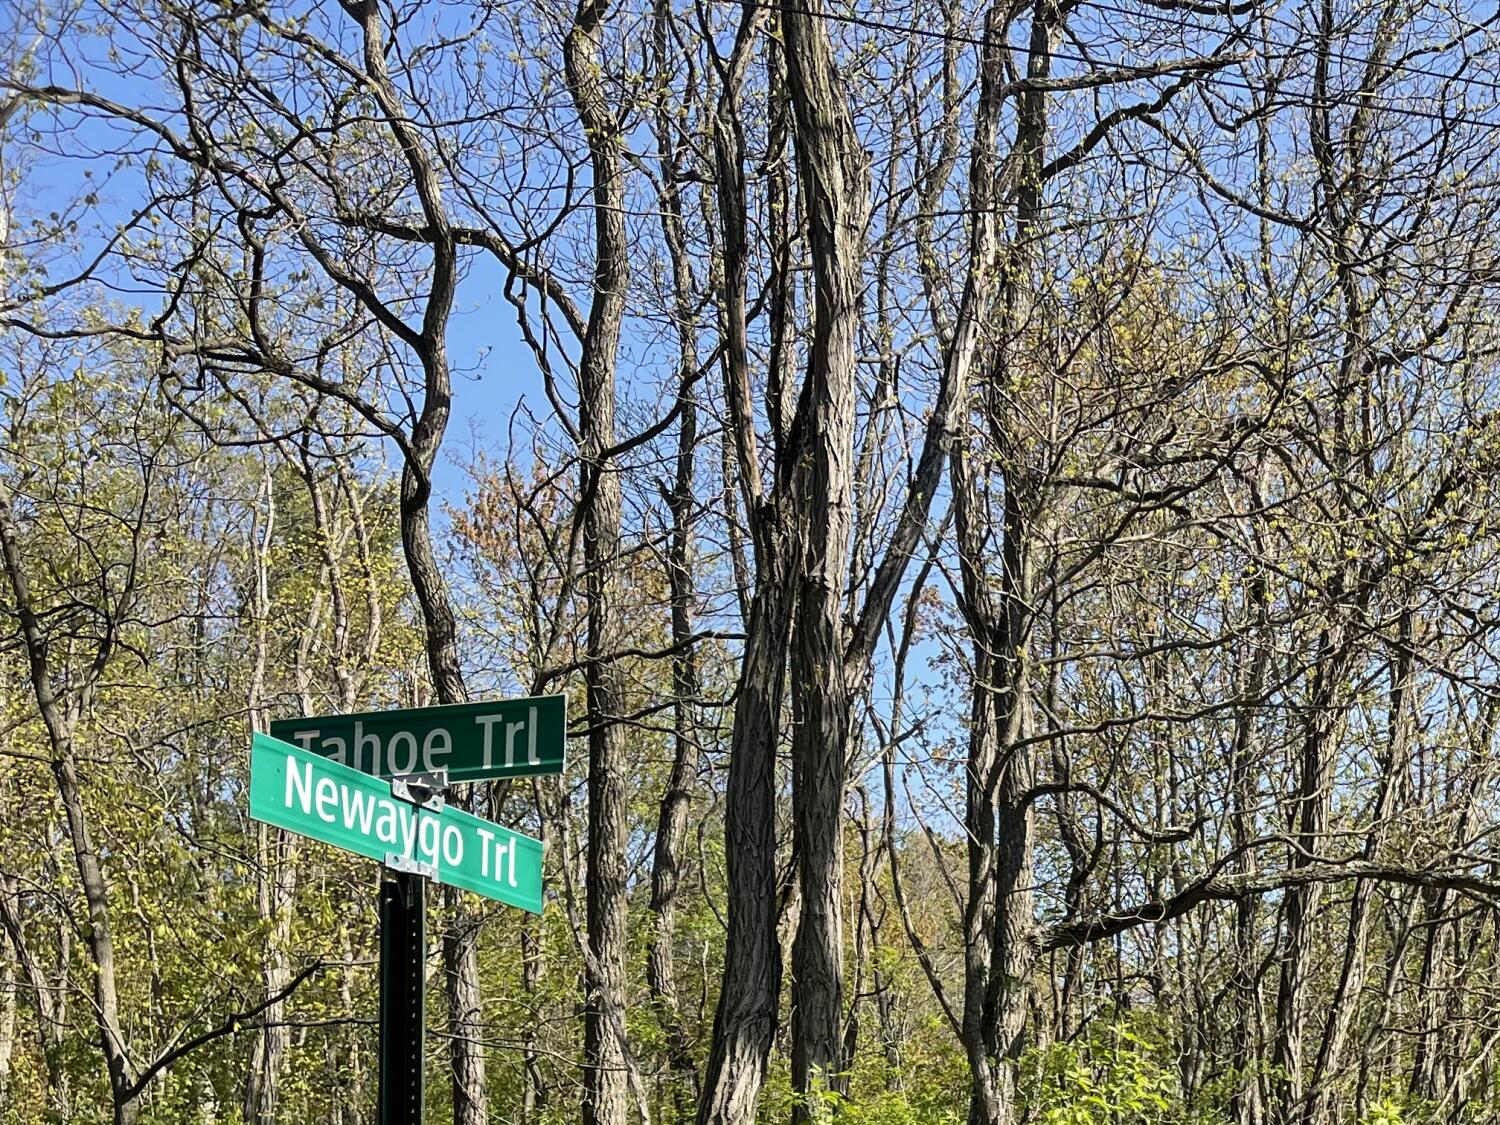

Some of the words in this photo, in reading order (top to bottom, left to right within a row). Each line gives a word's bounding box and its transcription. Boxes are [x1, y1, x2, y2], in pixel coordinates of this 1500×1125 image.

[475, 706, 541, 770] Trl
[284, 754, 464, 870] Newaygo
[477, 828, 518, 888] Trl
